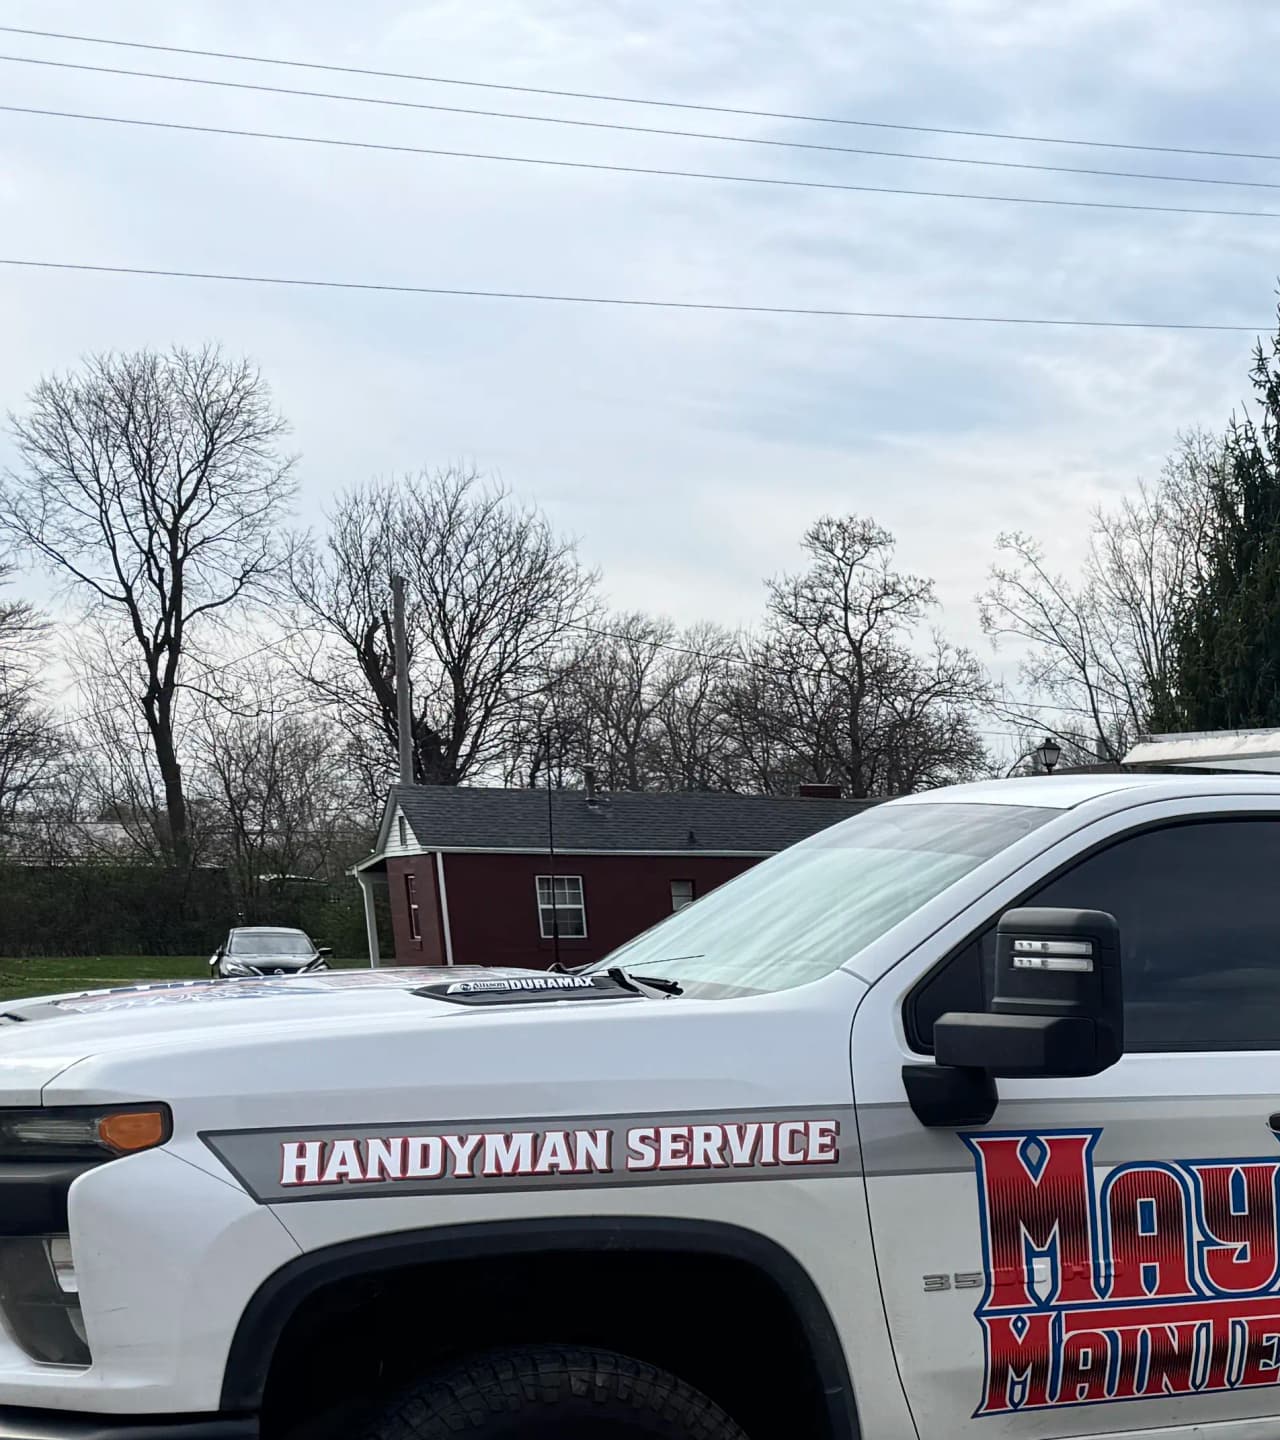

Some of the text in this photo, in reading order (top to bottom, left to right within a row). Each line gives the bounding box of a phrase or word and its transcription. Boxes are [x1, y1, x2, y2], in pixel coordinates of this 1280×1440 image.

[509, 976, 595, 990] DURAMAX
[280, 1120, 841, 1186] HANDYMAN SERVICE
